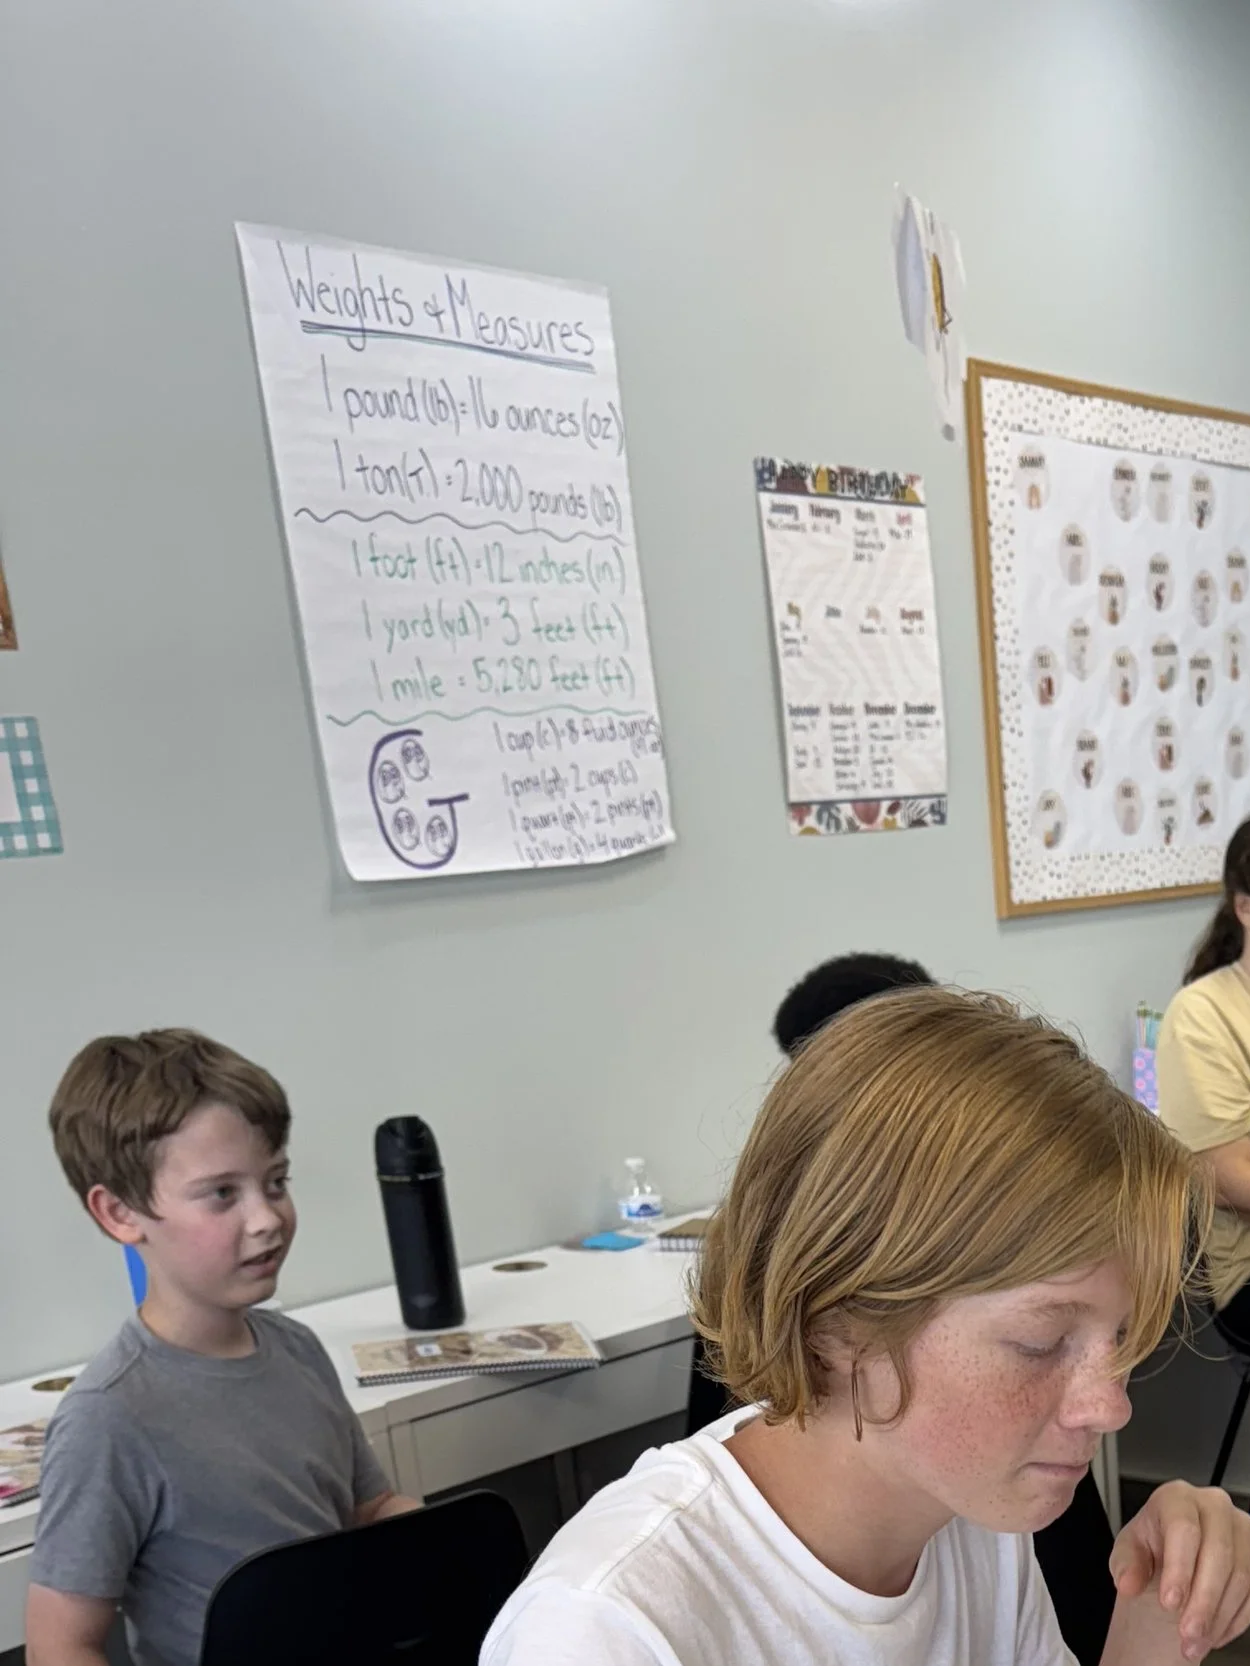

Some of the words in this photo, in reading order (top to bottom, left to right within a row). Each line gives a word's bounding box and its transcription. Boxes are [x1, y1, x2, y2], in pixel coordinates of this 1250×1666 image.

[276, 239, 414, 351] Weights
[444, 273, 596, 357] Measures
[498, 595, 522, 648] 3
[530, 597, 577, 644] feet
[391, 655, 447, 701] mile
[548, 654, 591, 695] feet
